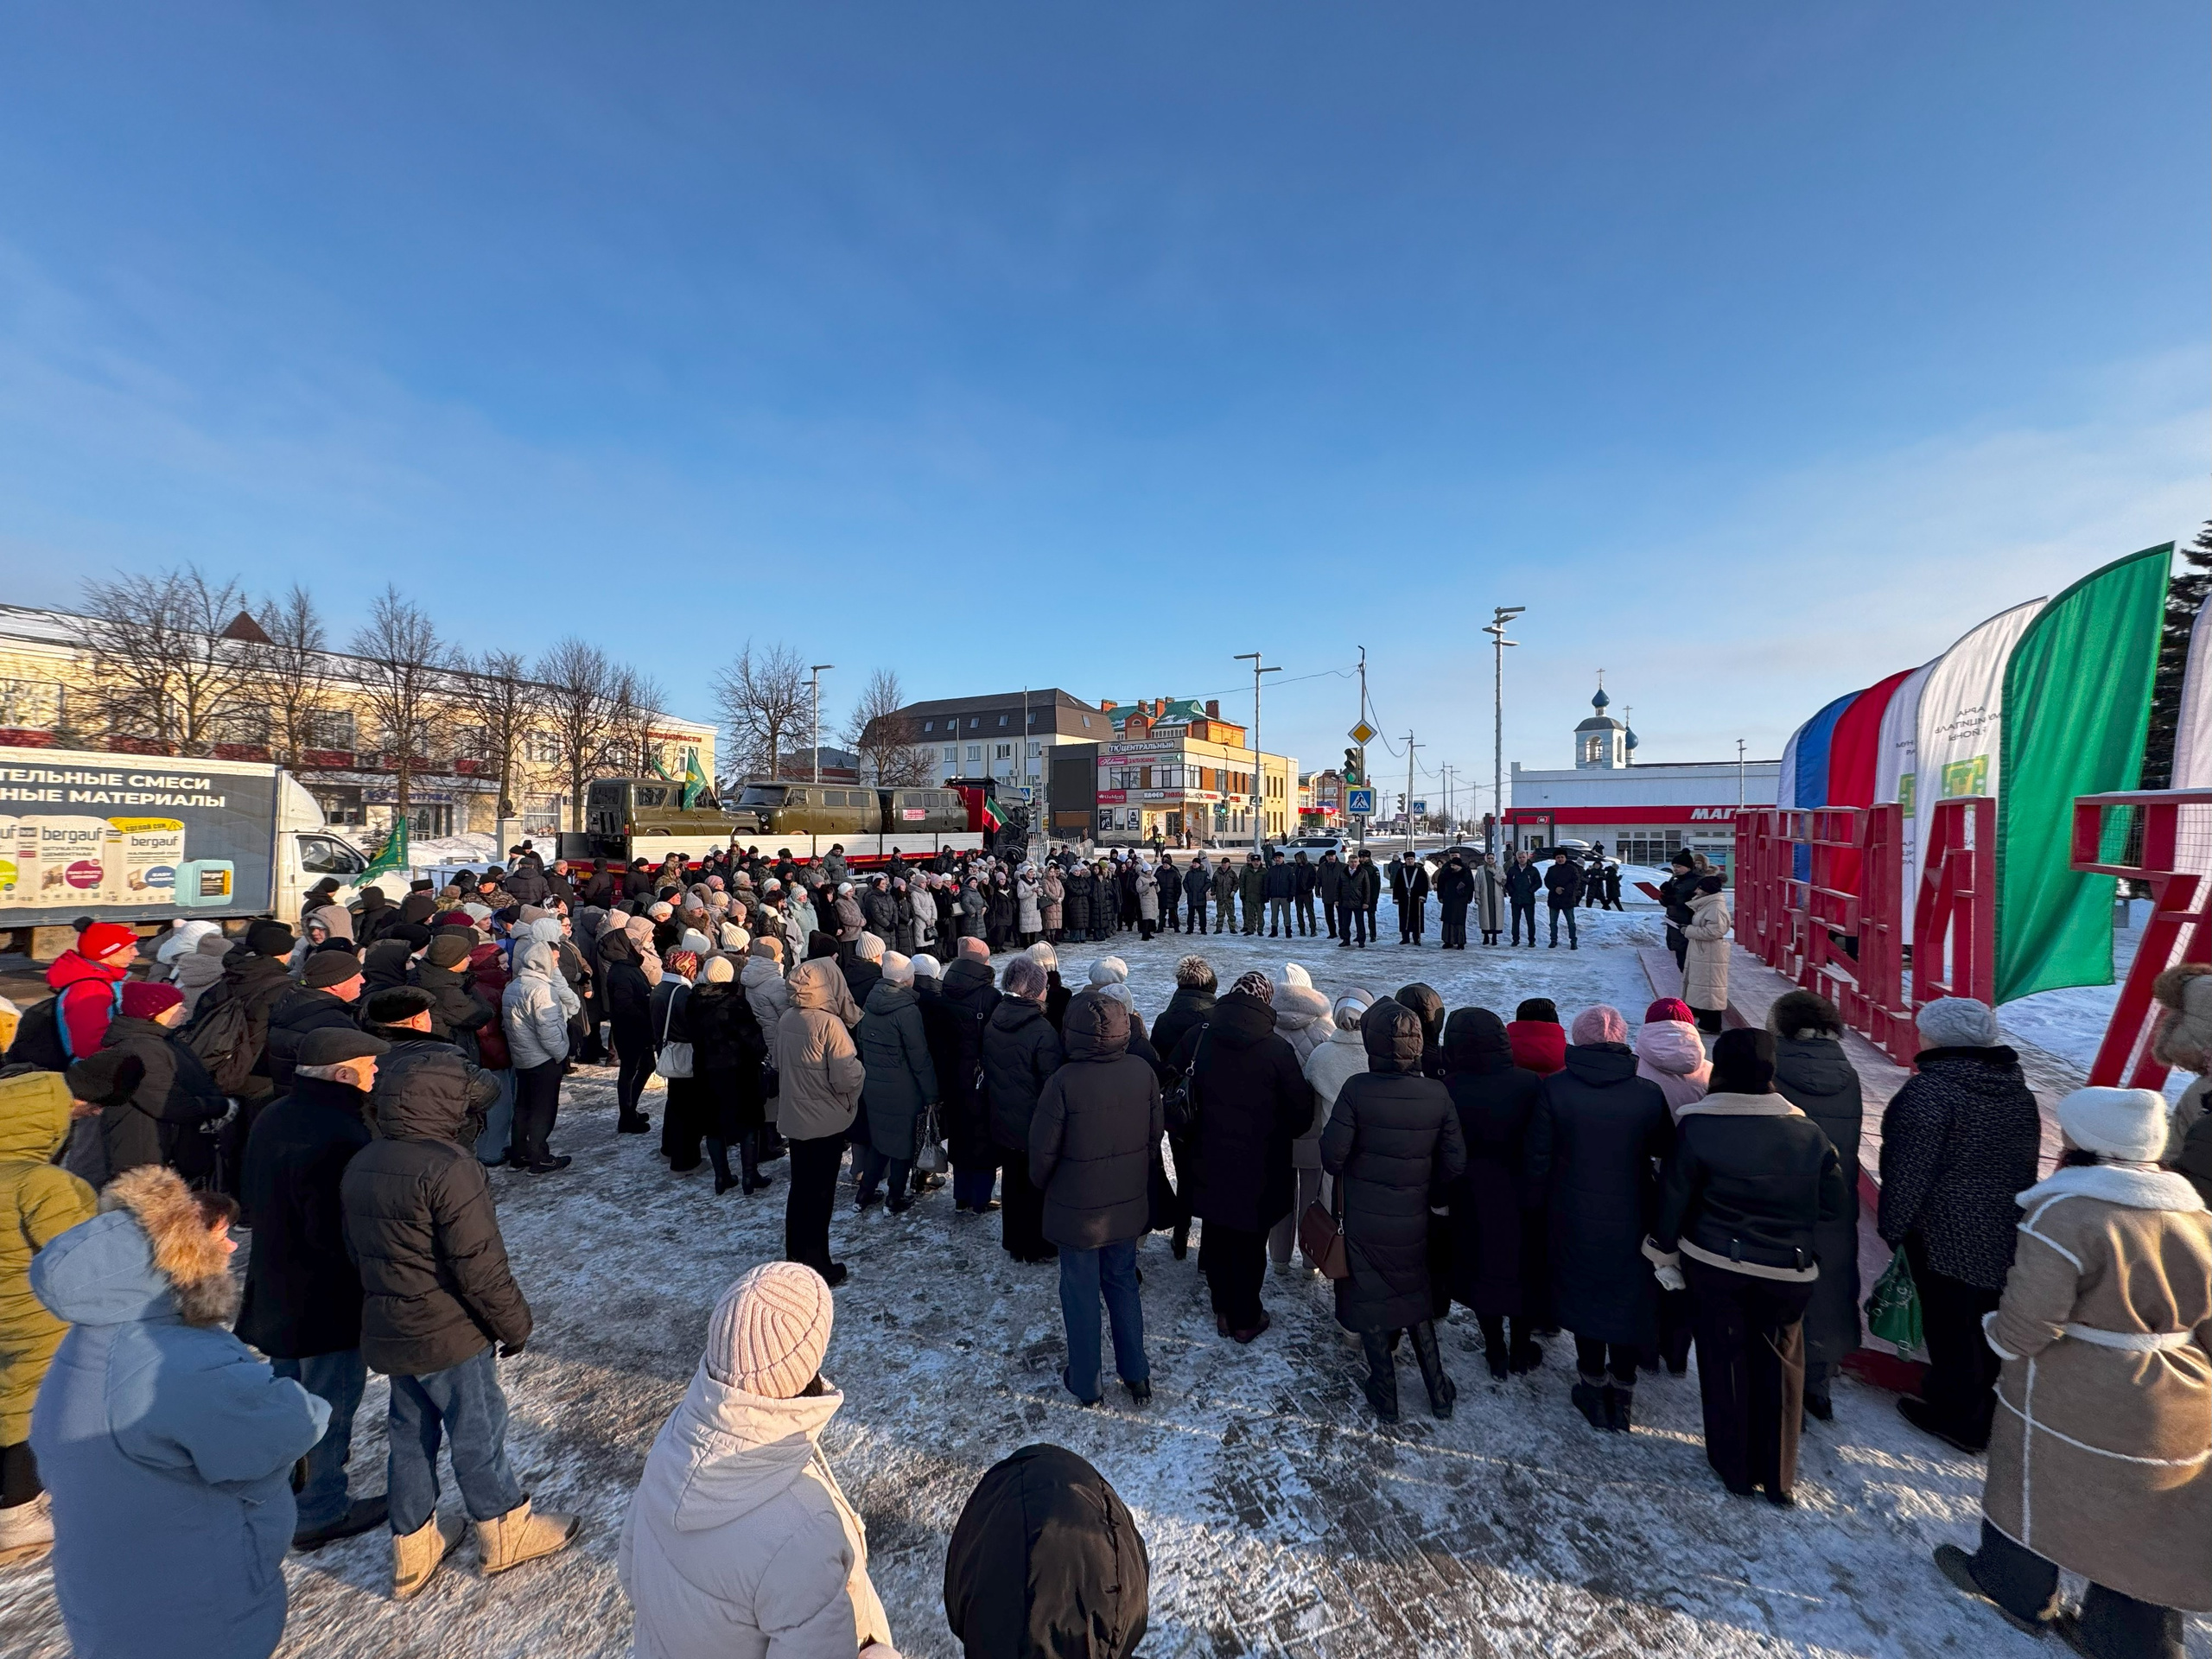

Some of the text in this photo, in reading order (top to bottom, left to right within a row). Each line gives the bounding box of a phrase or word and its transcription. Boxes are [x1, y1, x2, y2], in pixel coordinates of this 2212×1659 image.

[1121, 741, 1174, 753] ЦЕНТРАЛЬНЫЙ
[0, 768, 211, 790] ТЕЛЬНЫЕ СМЕСИ
[69, 790, 226, 807] МАТЕРИАЛЫ
[1690, 808, 1736, 820] МАГ
[41, 826, 103, 844] bergauf
[131, 836, 178, 848] bergauf
